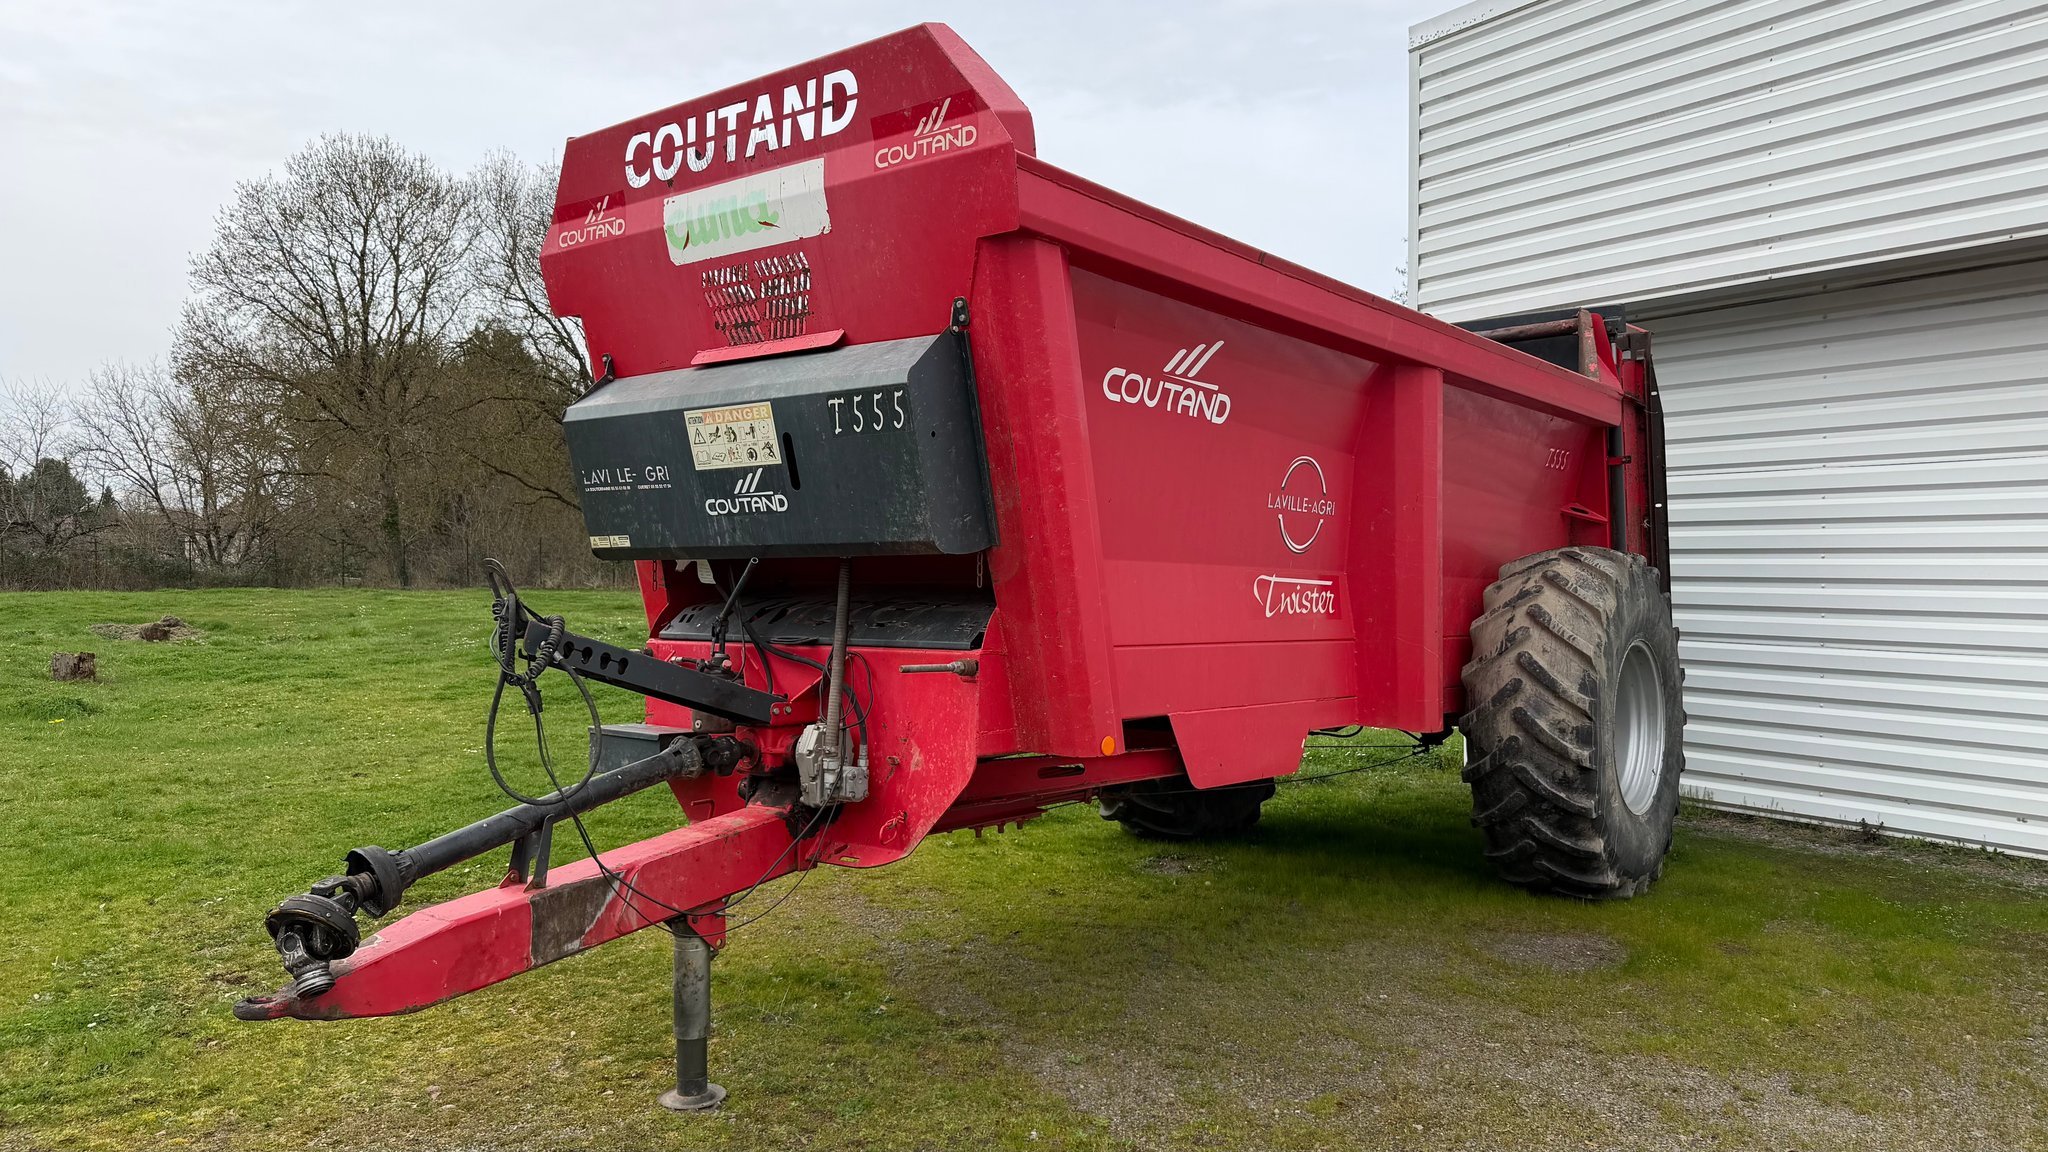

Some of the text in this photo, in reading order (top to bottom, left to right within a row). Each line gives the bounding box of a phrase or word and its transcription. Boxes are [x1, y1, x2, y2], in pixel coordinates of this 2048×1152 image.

[625, 69, 858, 188] COUTAND
[875, 125, 978, 170] COUTAND
[559, 219, 625, 247] COUTAND
[1103, 367, 1231, 424] COUTAND
[714, 406, 769, 423] DANGER
[706, 495, 788, 516] COUTAND
[1267, 493, 1336, 517] LAVILLE-AGRI
[1253, 574, 1336, 618] Twister
